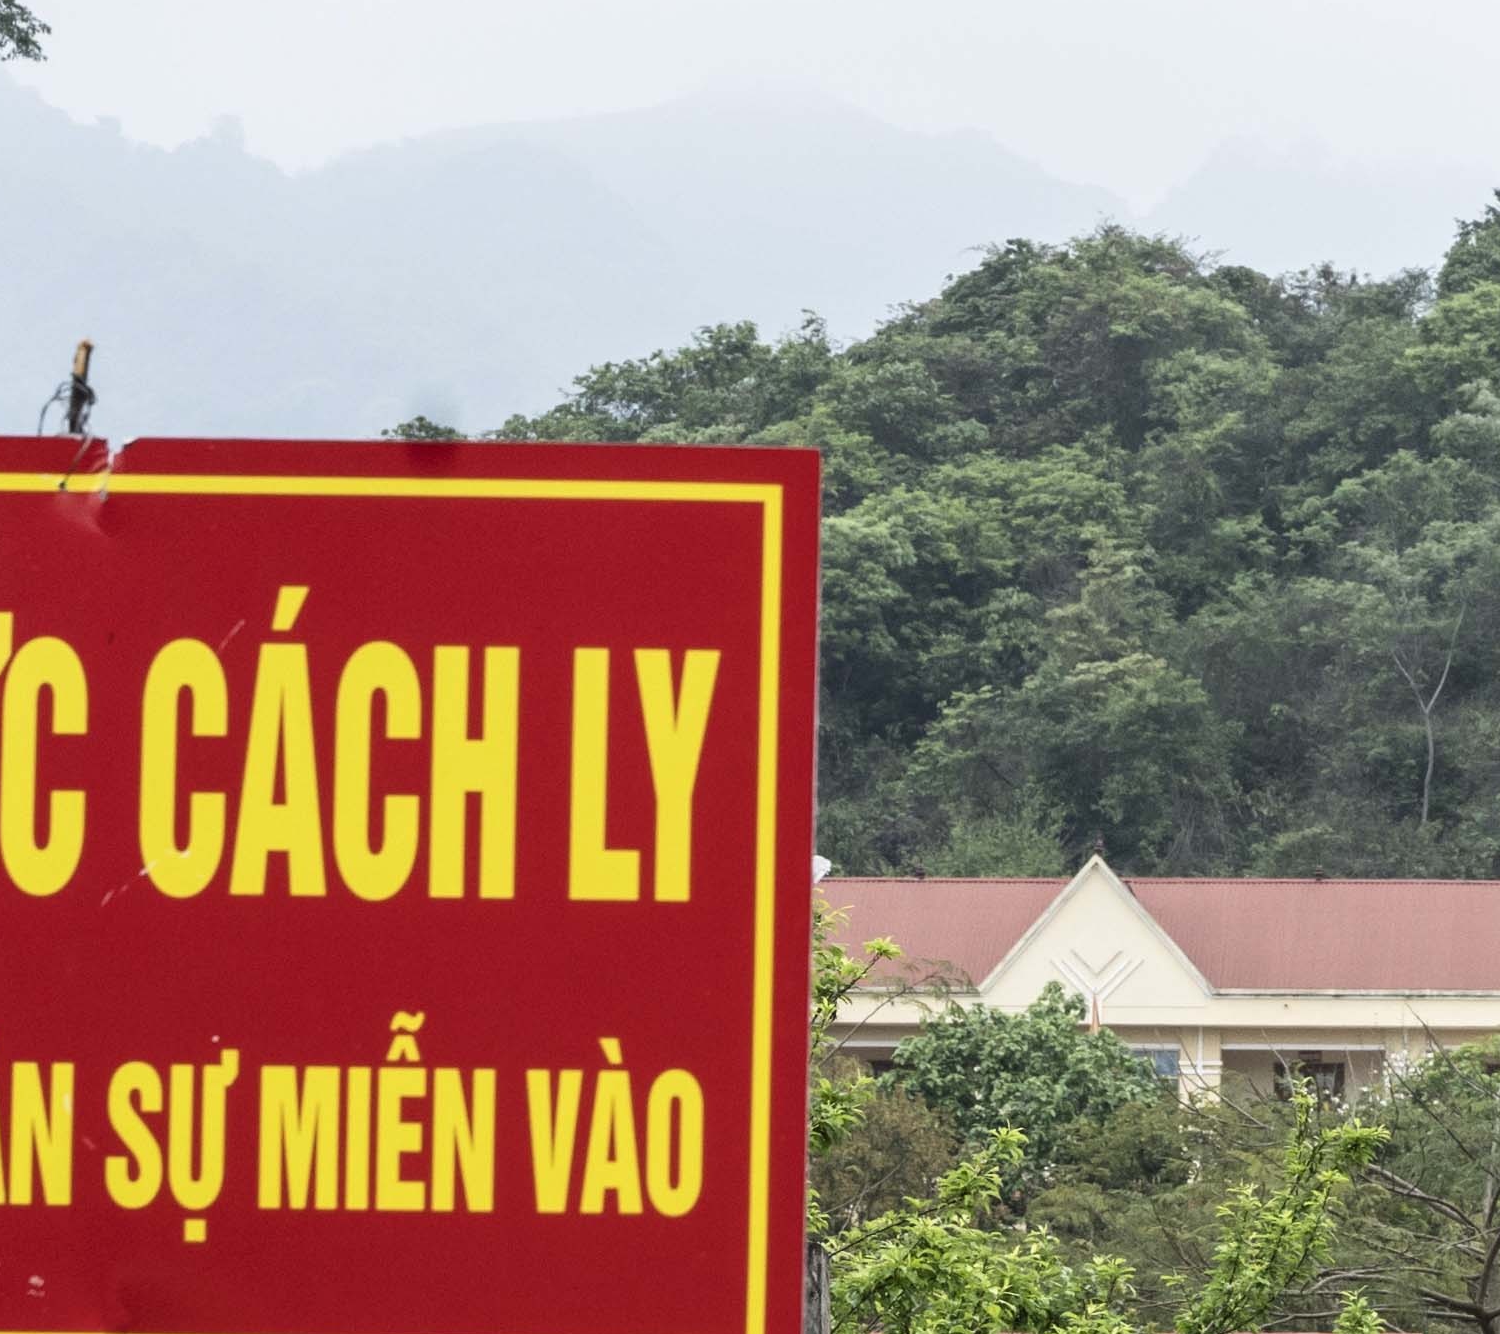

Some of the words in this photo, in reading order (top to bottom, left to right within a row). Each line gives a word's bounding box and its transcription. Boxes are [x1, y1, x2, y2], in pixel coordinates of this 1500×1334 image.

[140, 586, 519, 901] CÁCH
[569, 648, 720, 901] LY
[106, 1049, 239, 1242] SỰ
[259, 1012, 495, 1212] MIỄN
[527, 1038, 703, 1216] VÀO
